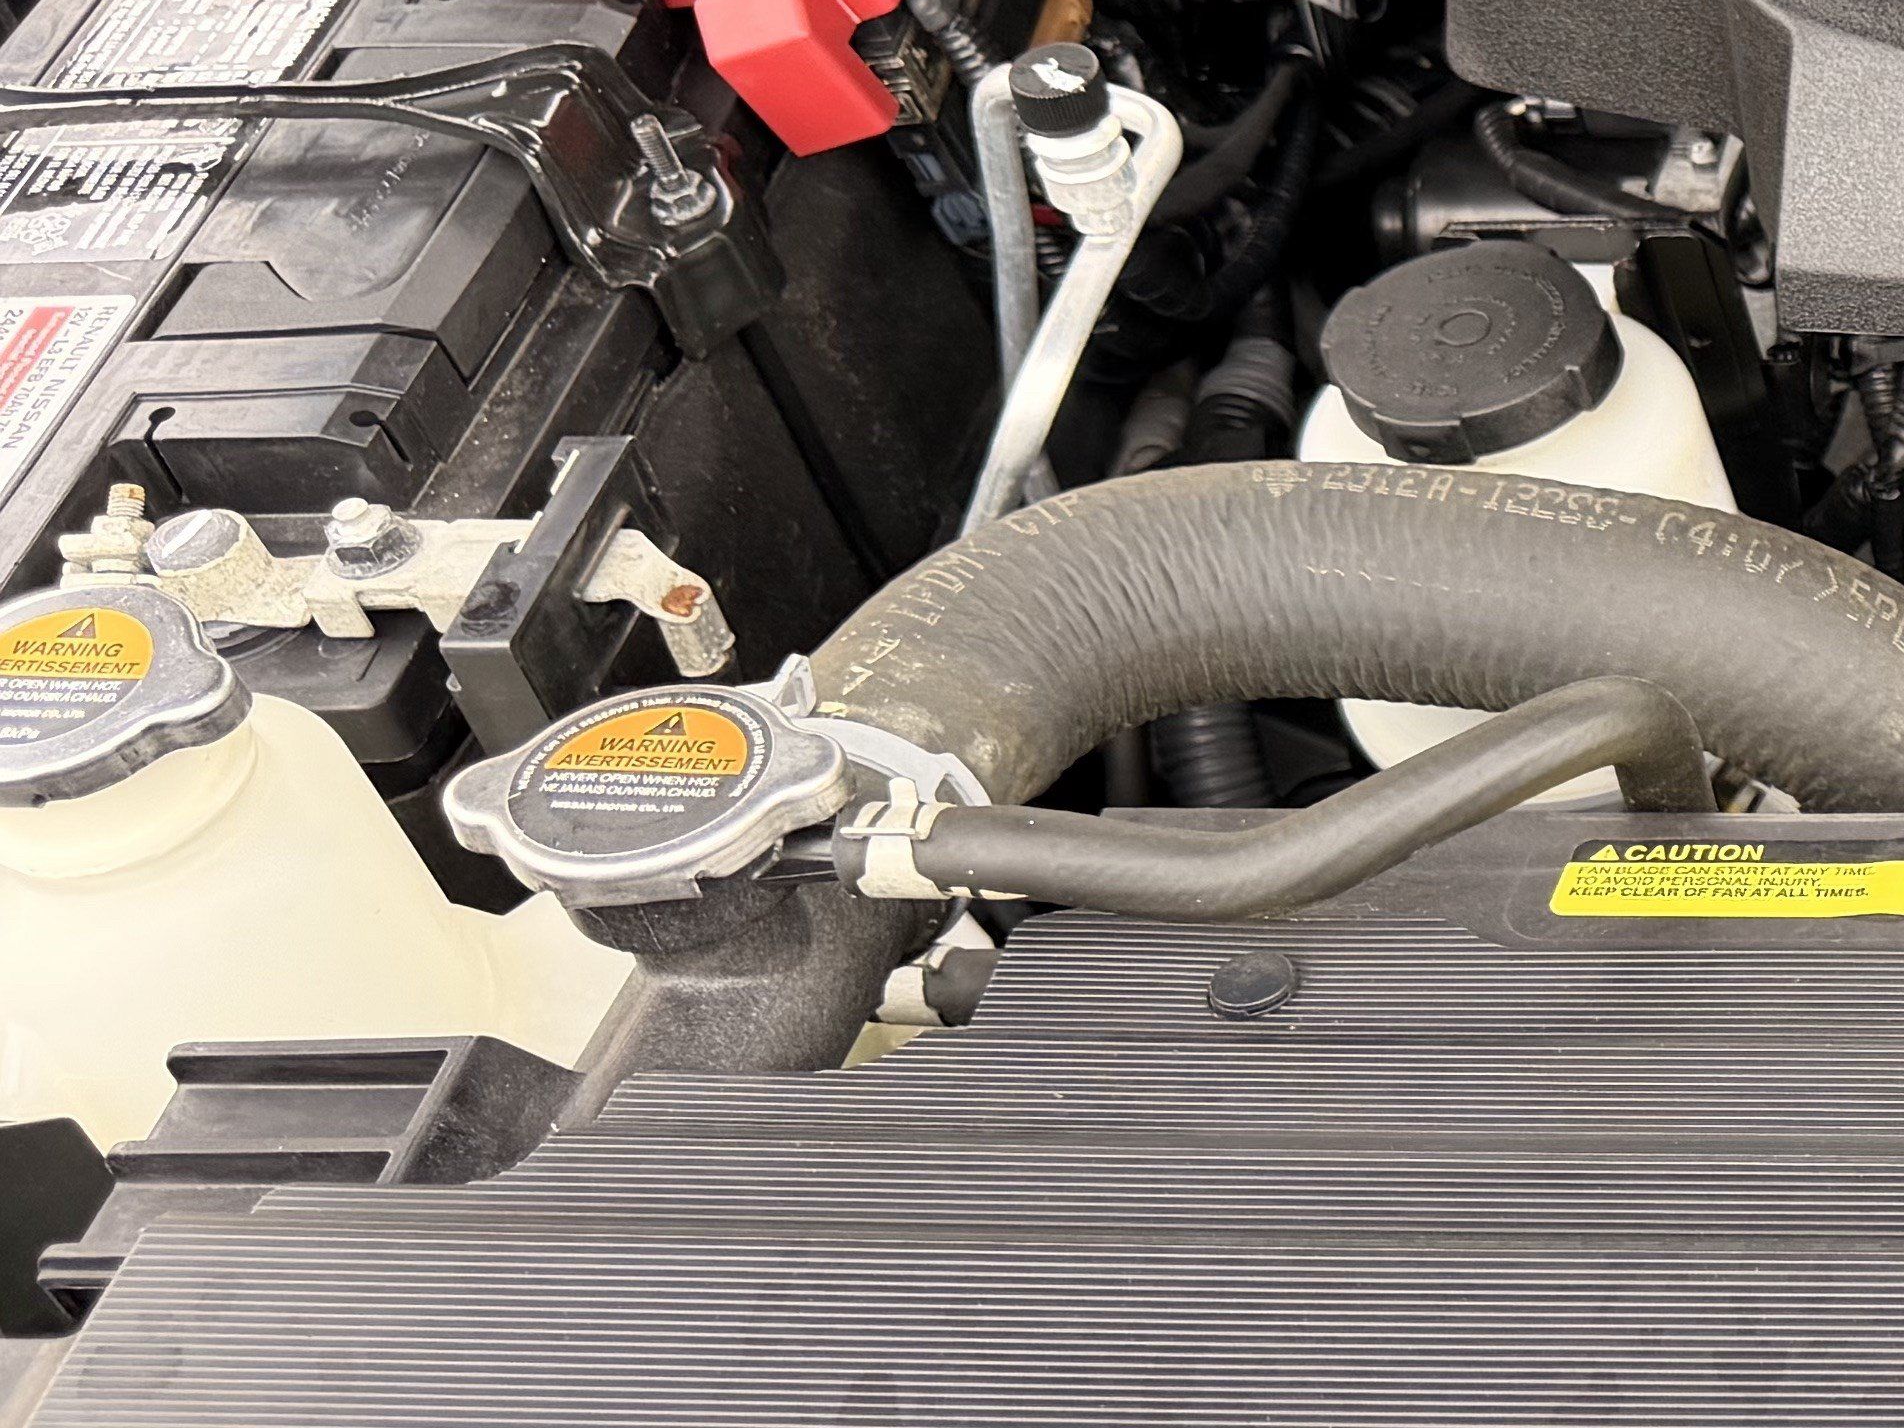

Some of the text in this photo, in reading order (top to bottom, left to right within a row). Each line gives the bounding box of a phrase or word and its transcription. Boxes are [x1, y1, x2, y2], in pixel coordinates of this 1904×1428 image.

[59, 306, 118, 371] RENAULT
[2, 379, 66, 449] NISSAN
[13, 640, 124, 658] WARNING
[0, 658, 140, 675] ERTISSEMENT
[599, 737, 716, 754] WARNING
[557, 753, 736, 771] AVERTISSEMENT
[600, 773, 640, 784] OPEN
[642, 774, 687, 785] WHEN
[1624, 844, 1765, 861] CAUTION
[1577, 866, 1611, 875] FAN
[1615, 866, 1674, 875] BLADE
[1677, 866, 1711, 875] CAN
[1713, 866, 1771, 875] START
[1771, 866, 1793, 876] AT
[1793, 866, 1829, 876] ANY
[1576, 876, 1597, 885] TO
[1600, 876, 1654, 885] AVOID
[1658, 876, 1751, 886] PERSONAL
[1568, 887, 1616, 897] KEEP
[1619, 887, 1679, 897] CLEAR
[1684, 887, 1704, 897] OF
[1711, 887, 1746, 897] FAN
[1749, 887, 1772, 897] AT
[1775, 887, 1809, 898] ALL
